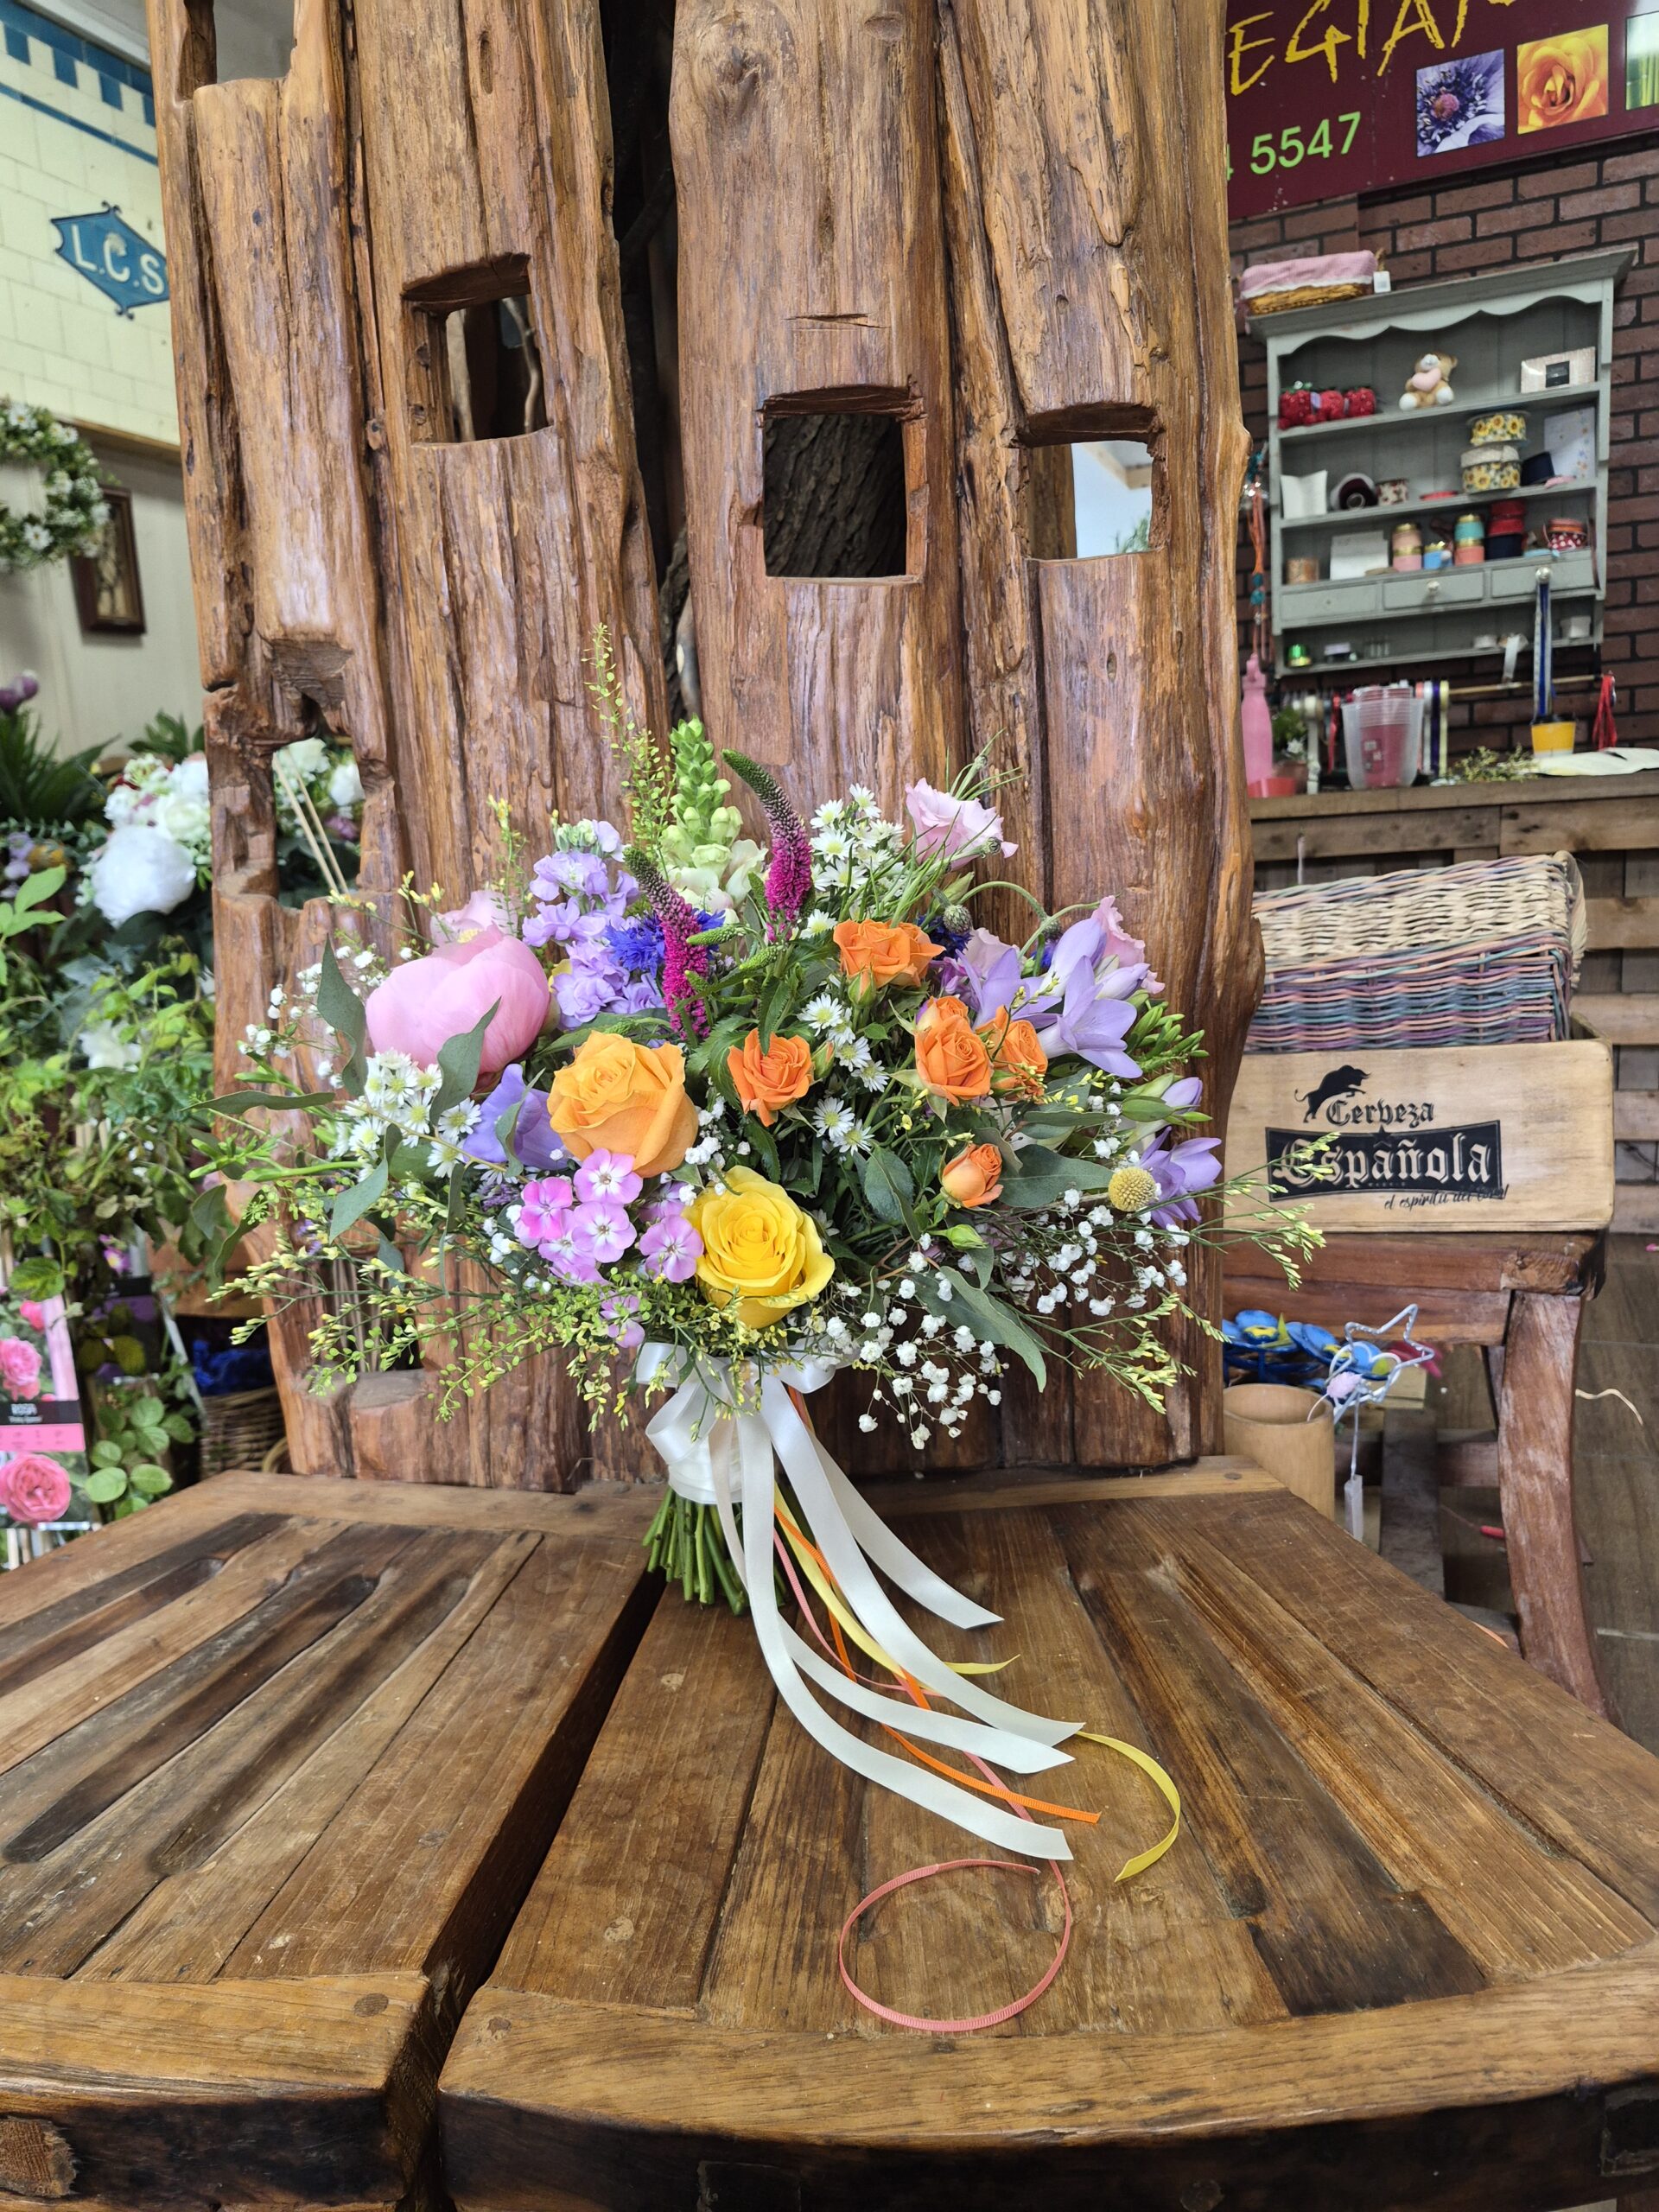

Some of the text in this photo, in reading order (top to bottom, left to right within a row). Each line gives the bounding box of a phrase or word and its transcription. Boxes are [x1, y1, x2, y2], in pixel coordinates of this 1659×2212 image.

[1249, 111, 1362, 175] 5547
[1325, 1098, 1434, 1128] Cerveza
[1272, 1133, 1491, 1188] Española
